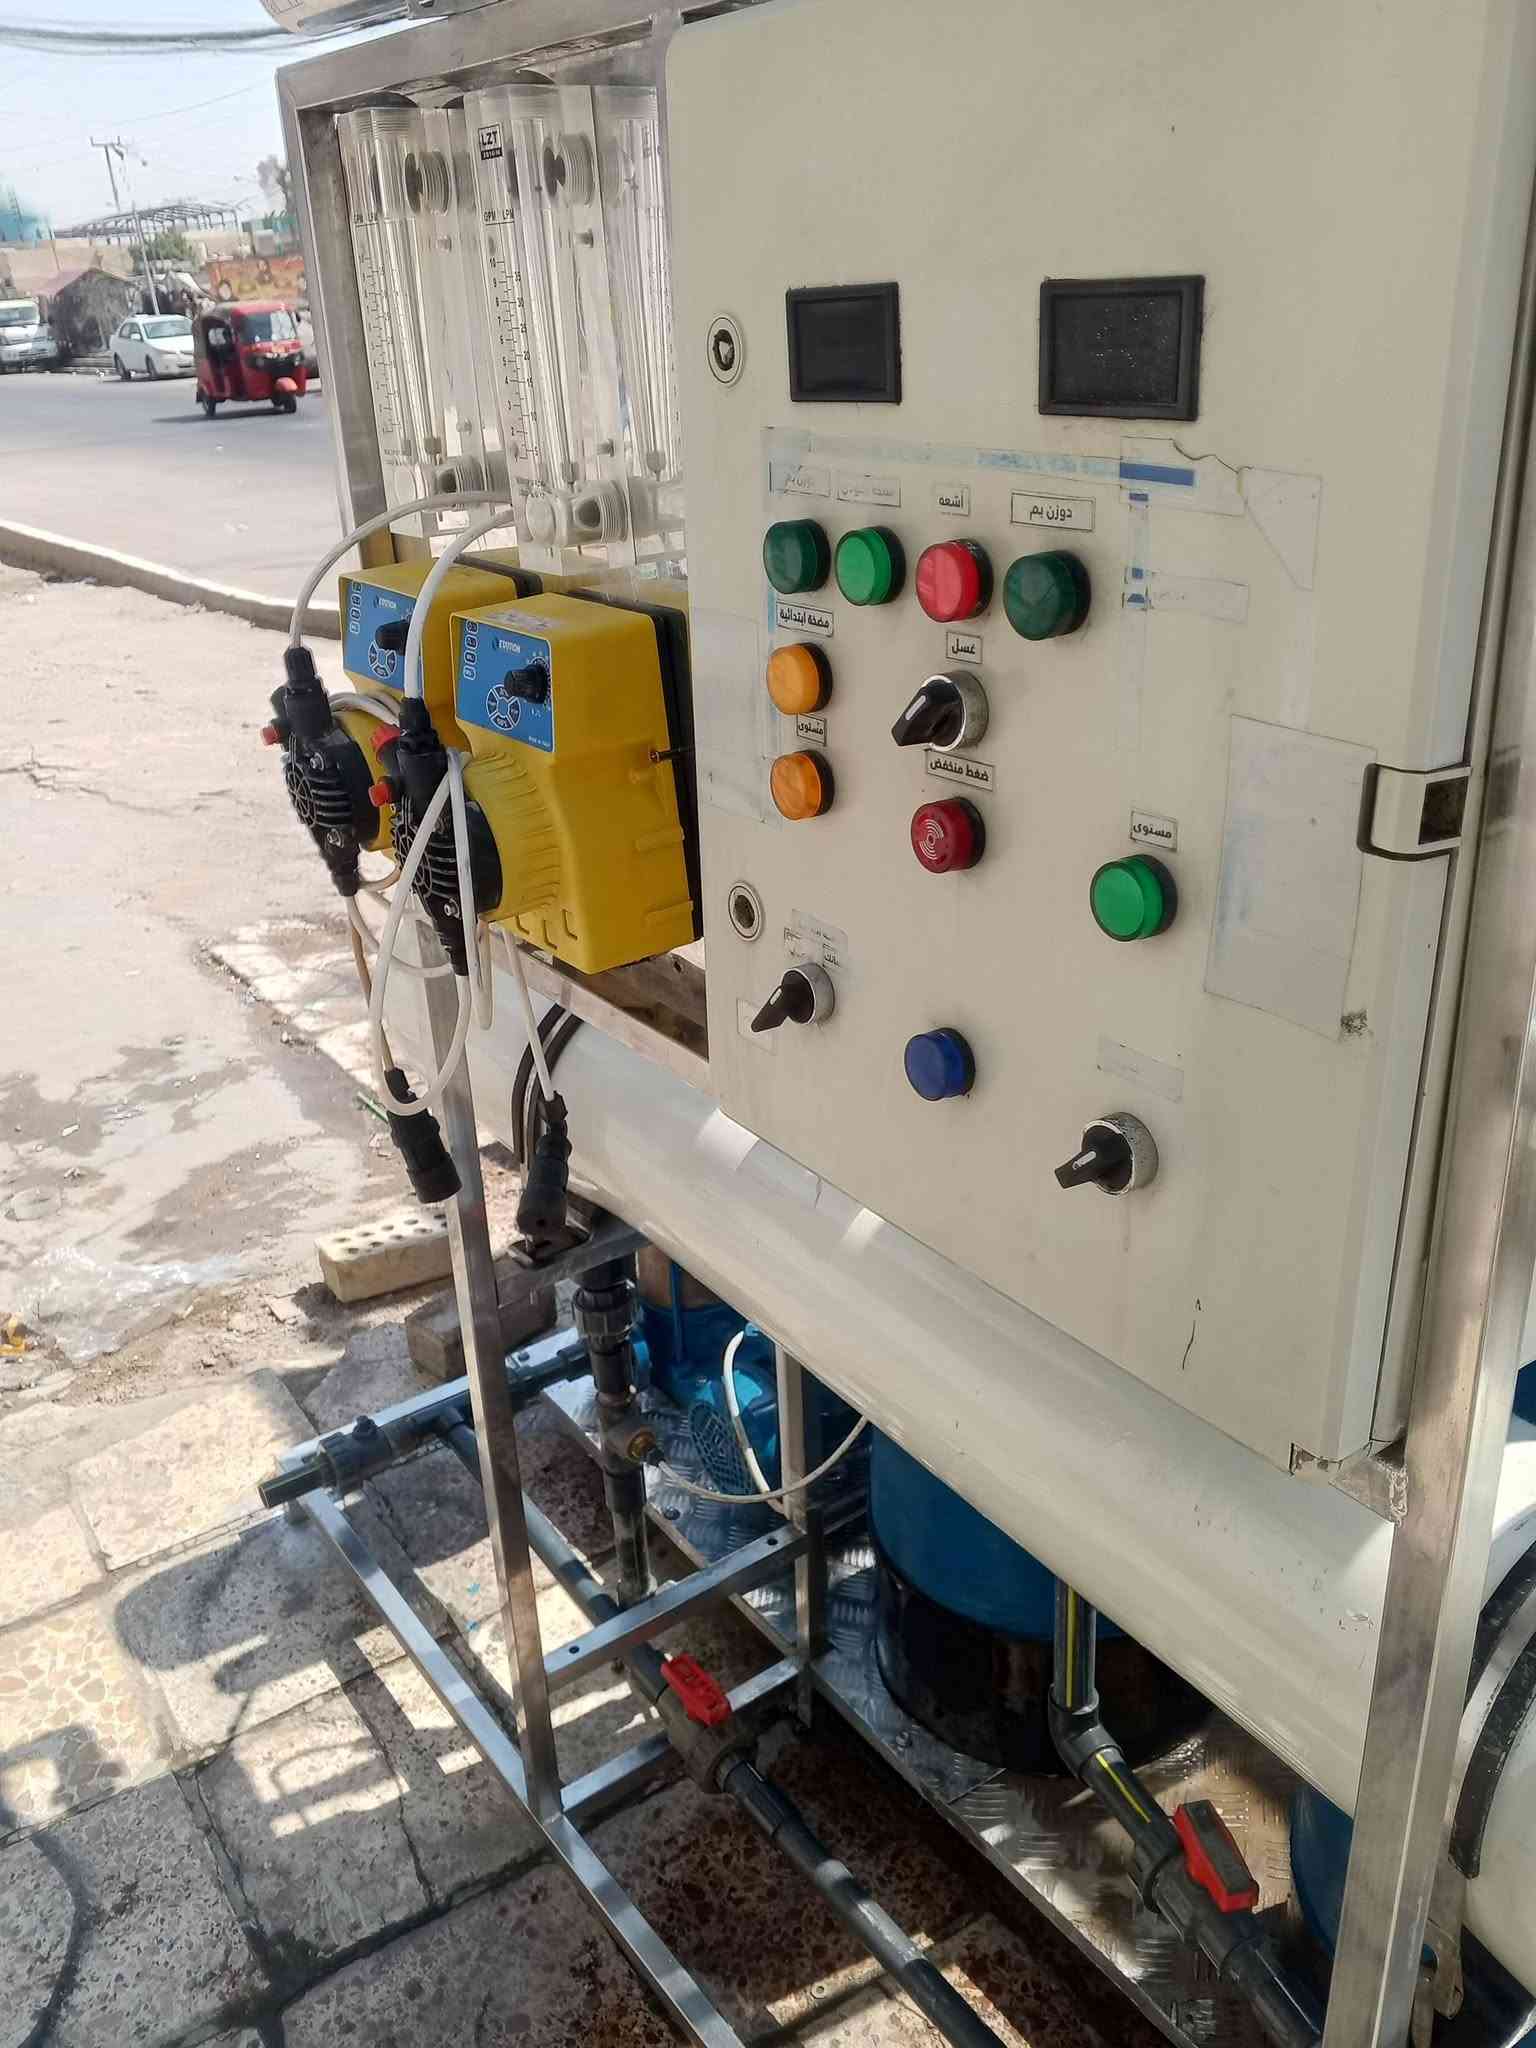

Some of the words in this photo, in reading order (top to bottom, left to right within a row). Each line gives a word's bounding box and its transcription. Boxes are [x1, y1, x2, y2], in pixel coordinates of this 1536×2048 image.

[481, 131, 498, 146] LZT
[1046, 503, 1073, 521] دوزن
[807, 614, 830, 629] مضخة
[951, 637, 976, 655] غسل
[929, 758, 964, 775] منخفض
[965, 763, 989, 782] ضغط
[1133, 823, 1172, 839] مستوى
